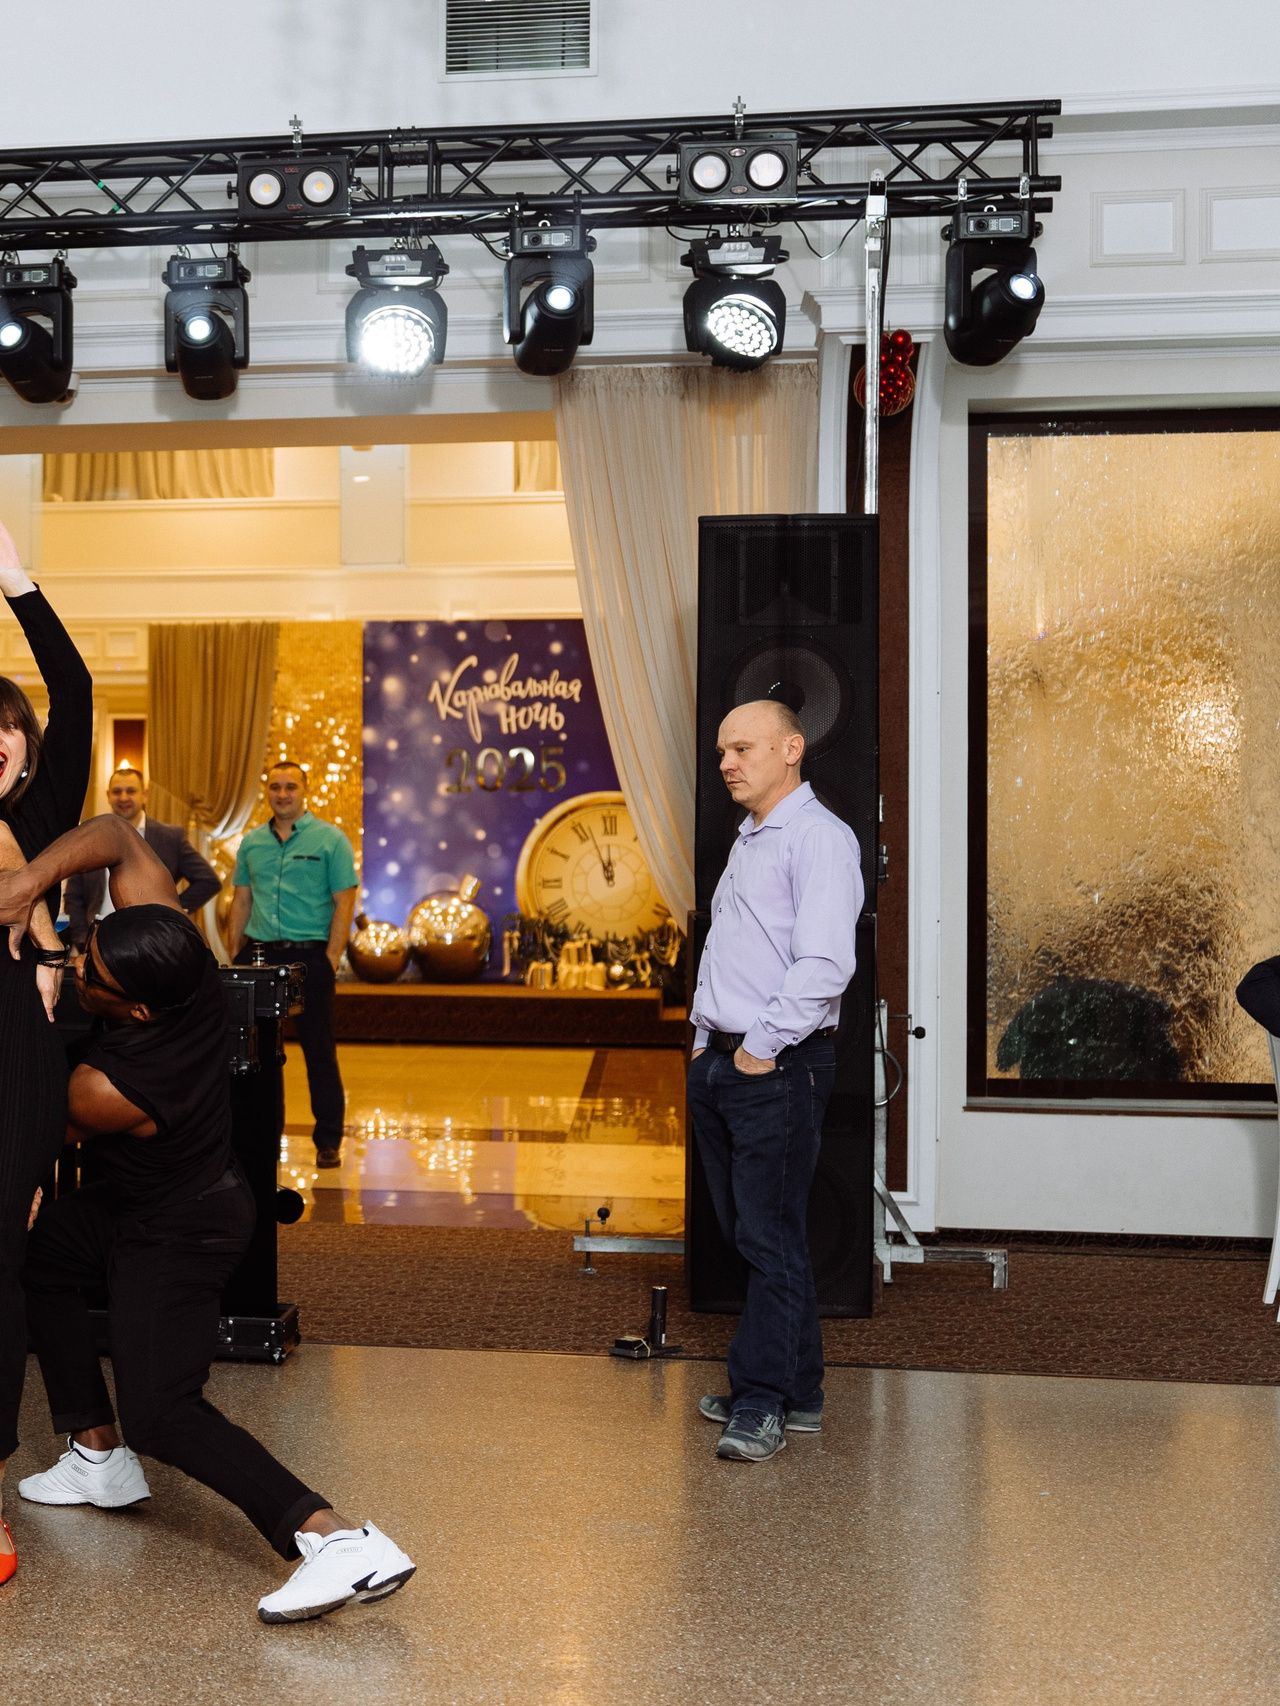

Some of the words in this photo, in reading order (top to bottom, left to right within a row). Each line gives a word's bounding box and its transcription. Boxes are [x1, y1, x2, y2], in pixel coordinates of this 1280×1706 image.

[428, 652, 582, 744] Карнавальная
[445, 747, 567, 793] 2025
[602, 814, 618, 836] XII
